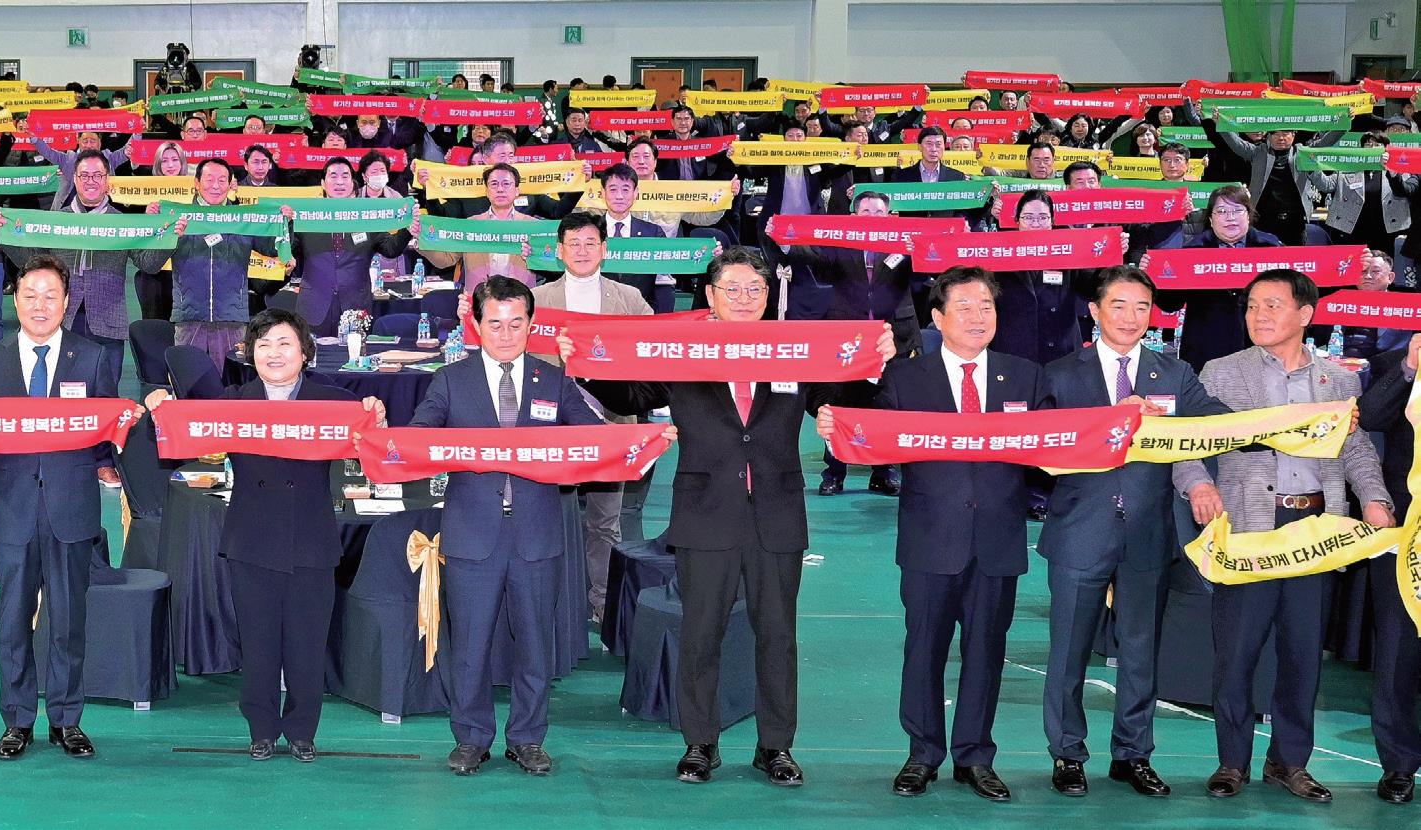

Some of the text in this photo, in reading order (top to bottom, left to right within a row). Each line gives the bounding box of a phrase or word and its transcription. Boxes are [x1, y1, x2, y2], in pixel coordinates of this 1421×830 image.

[449, 174, 561, 186] 경남과 대한민국
[119, 187, 188, 195] 경남과 함께 다시뛰는
[642, 193, 708, 201] 다시뛰는 대한민국
[892, 191, 975, 200] 경남에서 희망찬 감동체전
[1053, 200, 1145, 212] 기찬 경남 행복한 도민
[299, 210, 394, 220] 경남에서 희망찬 감동체전
[25, 223, 154, 237] 활기찬 경남에서 희망찬 감동체전
[438, 230, 464, 240] 활기찬
[466, 231, 500, 242] 경남에서
[813, 229, 899, 242] 활기찬 경남 행복한
[623, 251, 690, 260] 희망찬 감동체전
[957, 244, 1073, 258] 활기찬 경남 행복한 도민
[1193, 263, 1227, 275] 활기찬
[1231, 263, 1254, 273] 경남
[1294, 261, 1315, 273] 도민
[1326, 303, 1413, 318] 활기찬 경남 행복한
[635, 341, 809, 359] 활기찬 경남 행복한 도민
[21, 417, 65, 433] 행복한
[69, 415, 98, 431] 도민
[188, 421, 349, 440] 활기찬 경남 행복한 도민
[897, 432, 1077, 450] 활기찬 경남 행복한 도민
[1140, 437, 1173, 450] 함께
[429, 445, 599, 462] 활기찬 경남 행복한 도민
[1257, 555, 1290, 570] 함께
[1294, 532, 1355, 563] 다시뛰는
